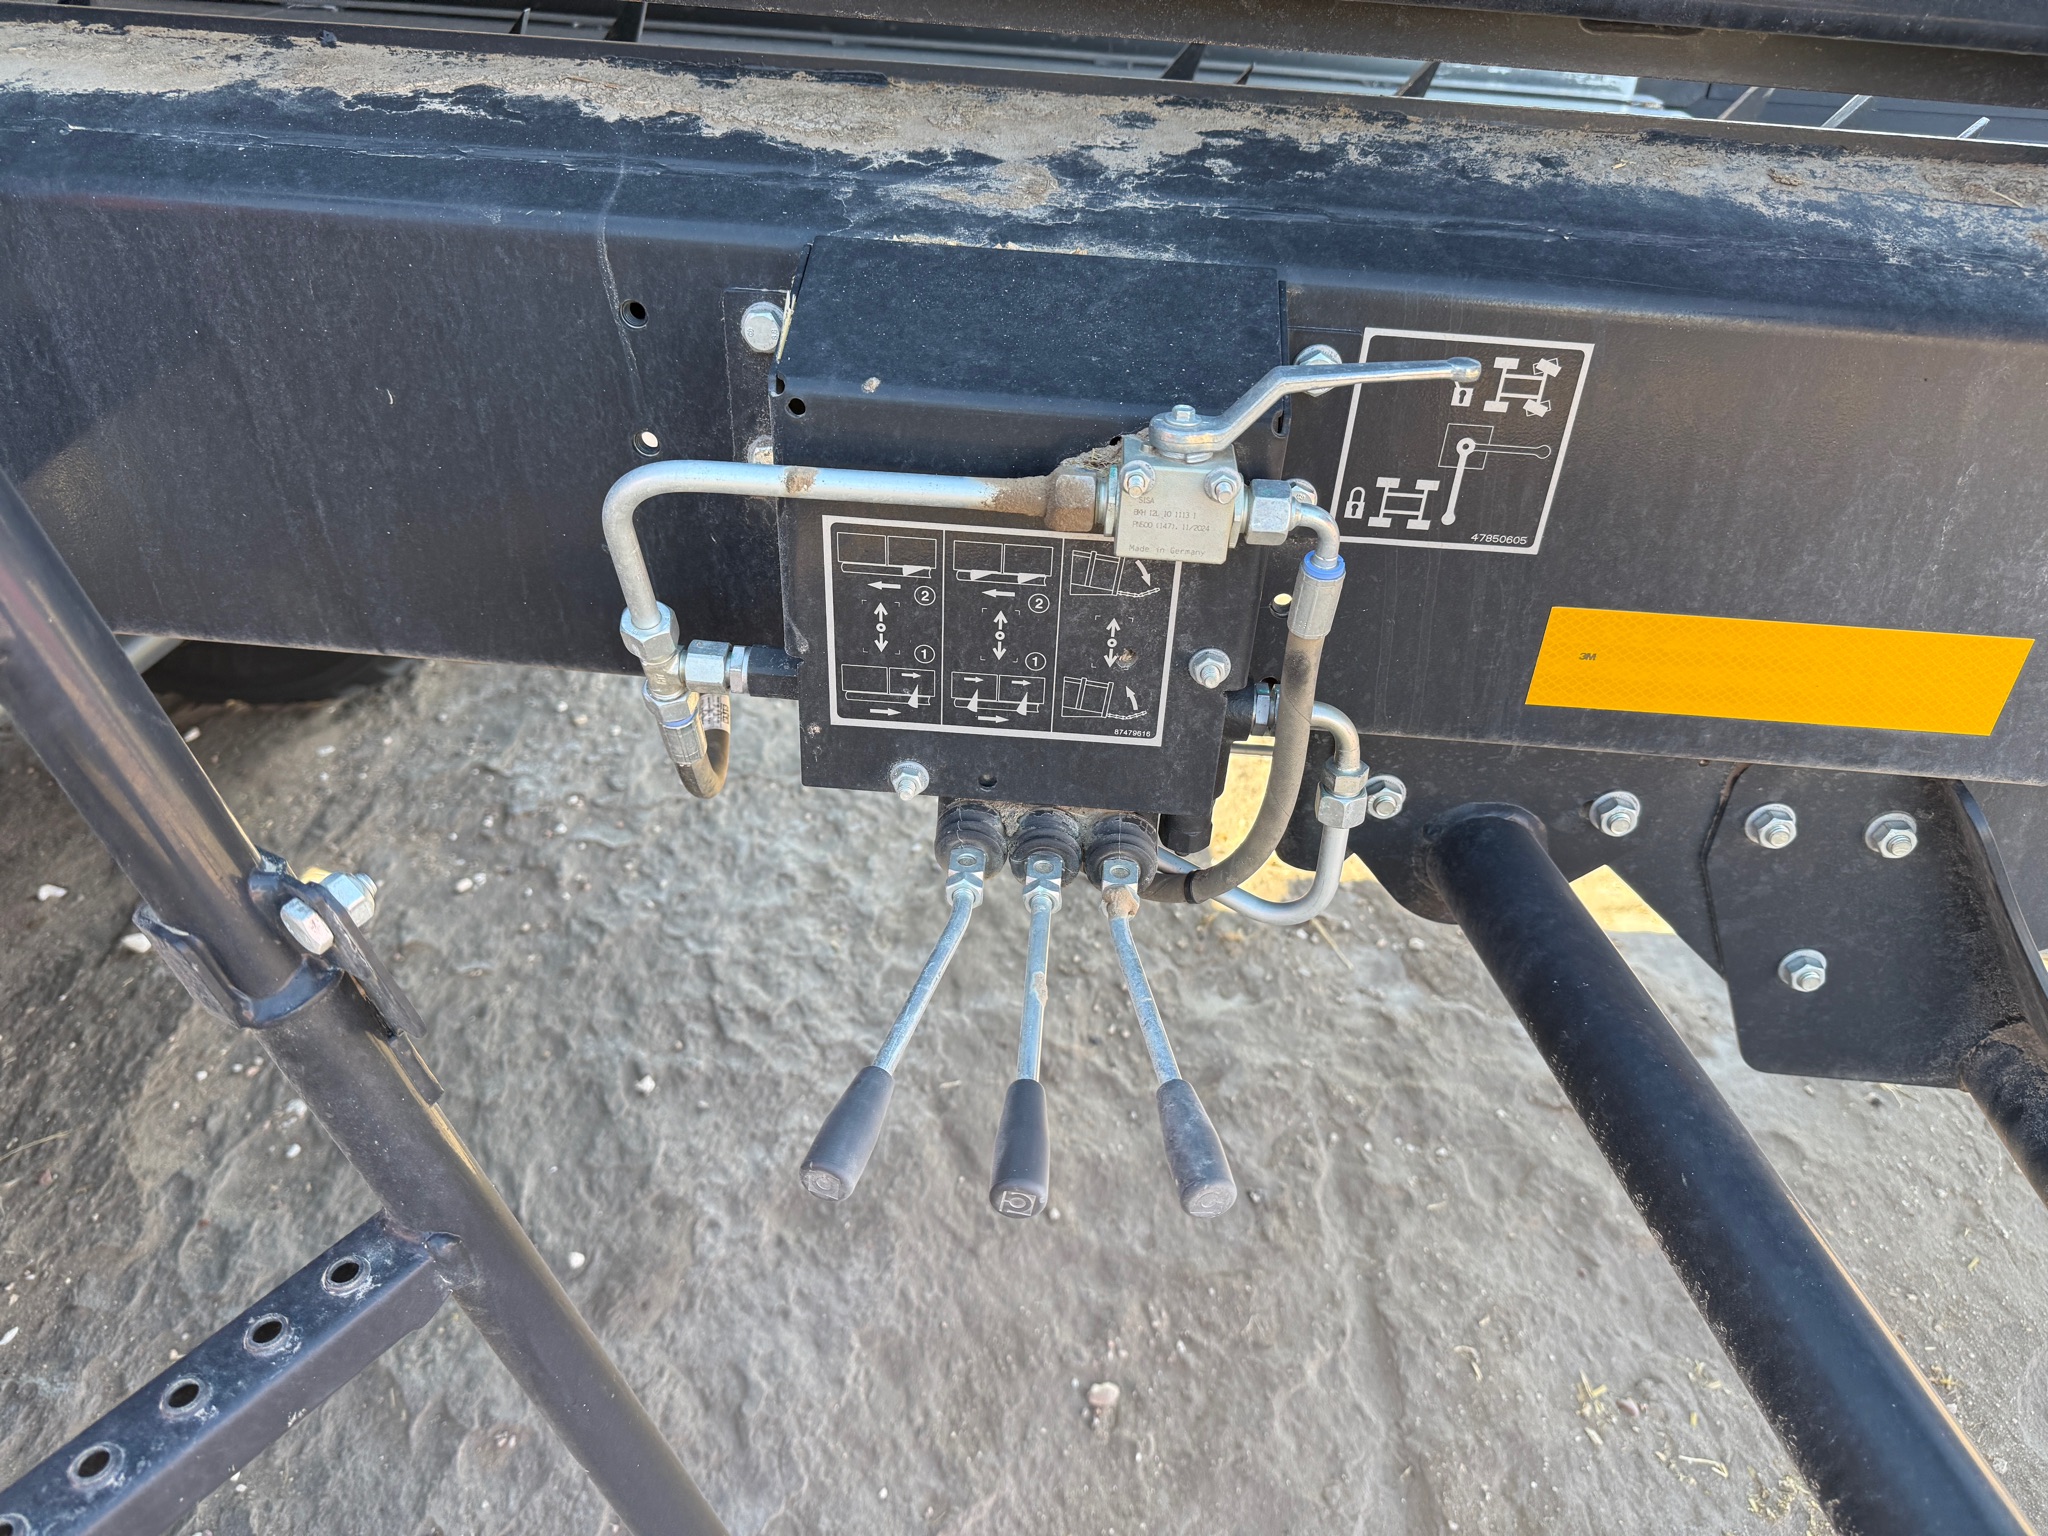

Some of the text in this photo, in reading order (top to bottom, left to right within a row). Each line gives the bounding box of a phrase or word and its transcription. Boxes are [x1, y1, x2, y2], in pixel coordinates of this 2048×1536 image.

[1182, 524, 1210, 532] 11/2024
[1471, 533, 1527, 544] 47850605
[1128, 544, 1206, 556] Made in Germany
[1578, 652, 1597, 661] 3M
